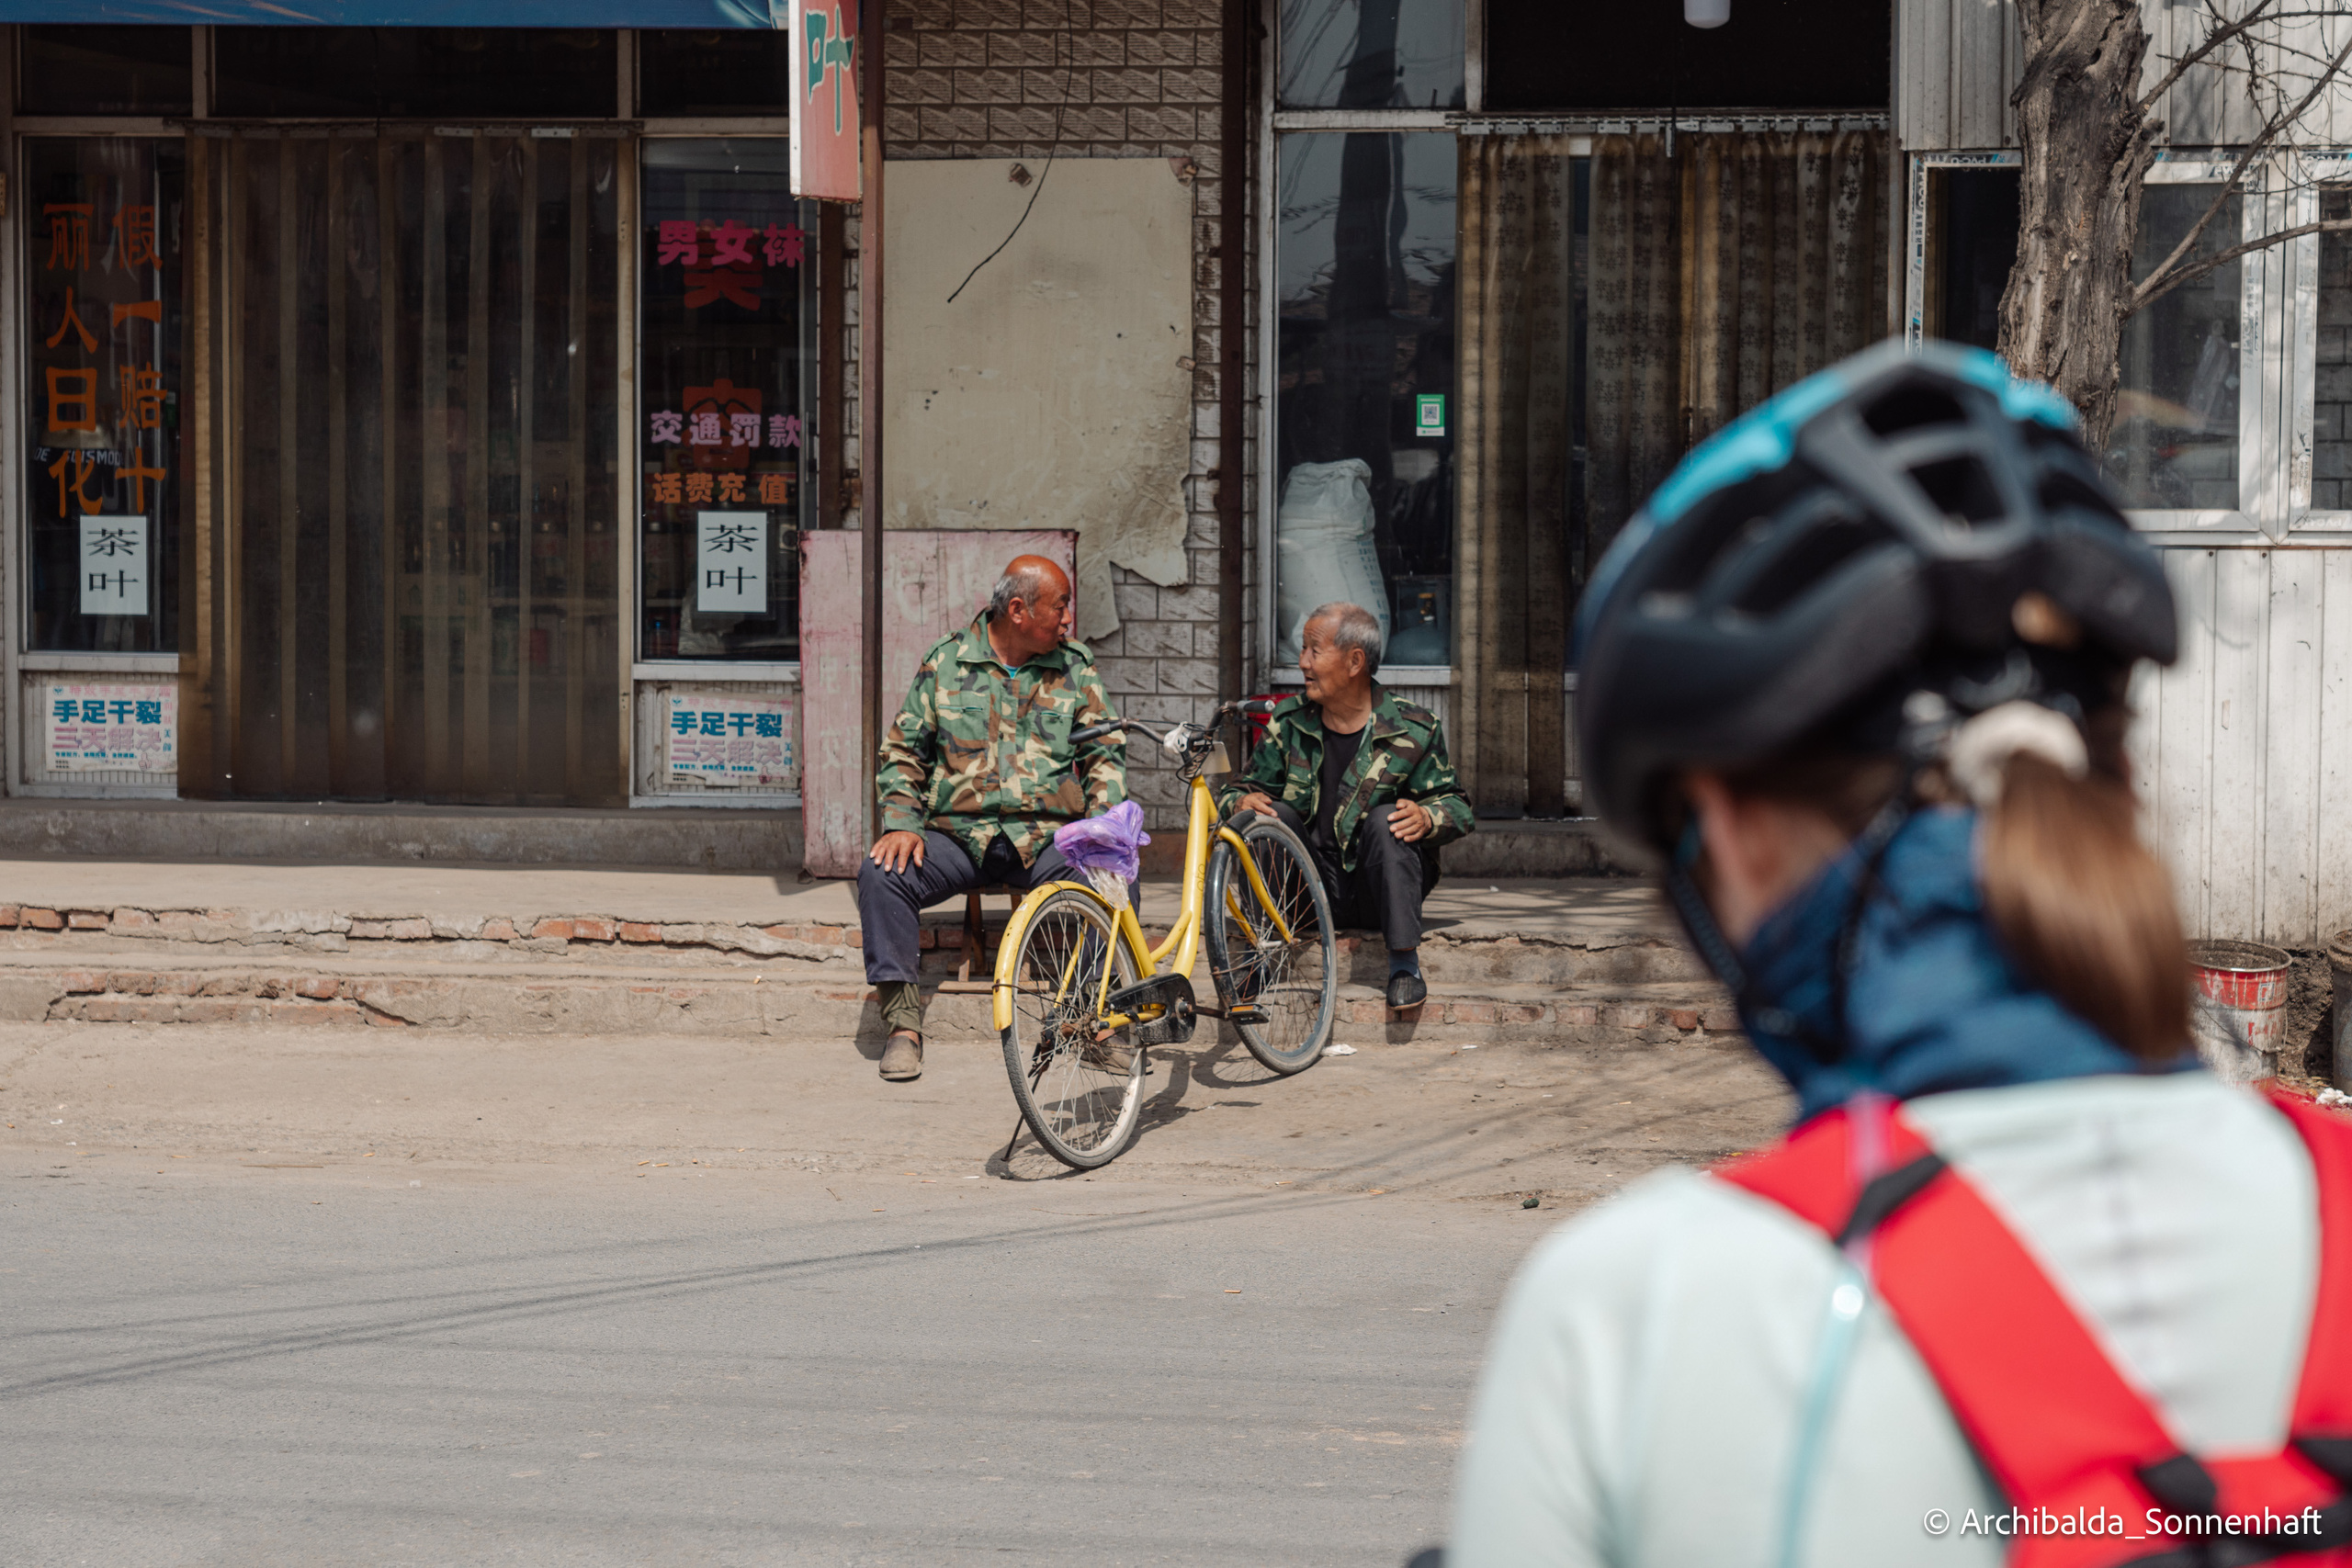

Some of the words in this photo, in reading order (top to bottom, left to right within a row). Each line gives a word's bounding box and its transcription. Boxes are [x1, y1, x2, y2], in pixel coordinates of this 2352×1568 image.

[805, 3, 855, 136] 叶
[657, 219, 806, 267] 男女袜
[43, 202, 104, 519] 丽人日化
[111, 203, 168, 515] 假一赔十
[650, 410, 803, 449] 交通罚款
[652, 472, 789, 504] 话费充值
[86, 527, 140, 599] 茶叶
[705, 524, 760, 596] 茶叶
[52, 700, 162, 725] 手足干裂
[671, 711, 783, 738] 手足干裂
[52, 727, 162, 752] 三天解决
[671, 739, 783, 765] 三天解决
